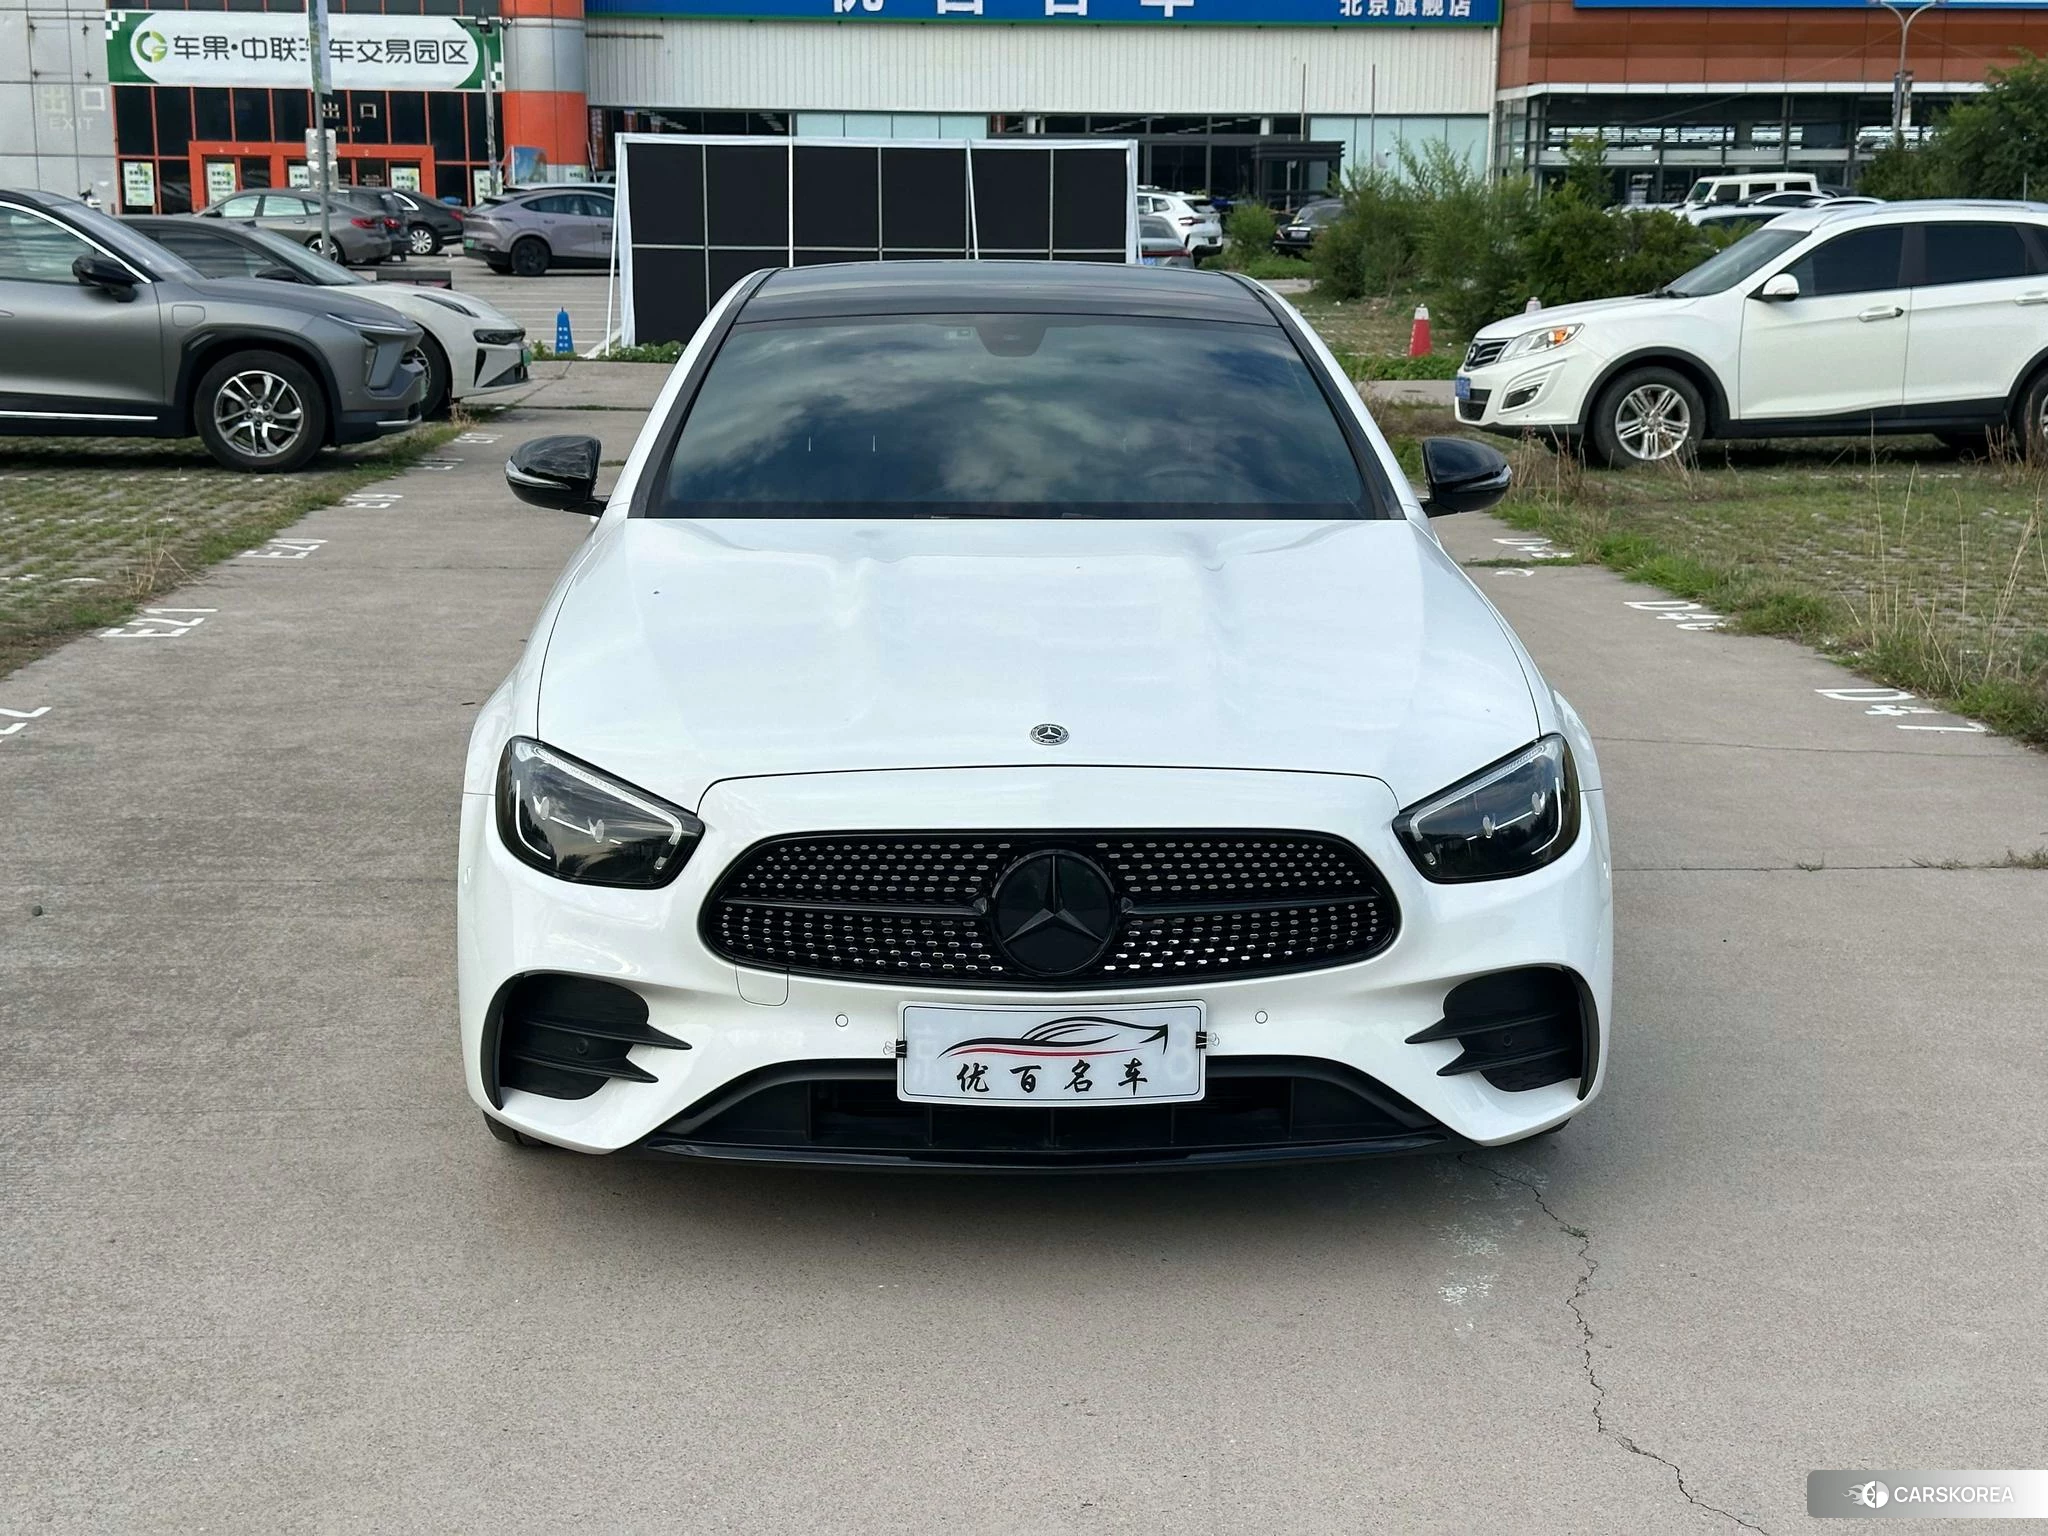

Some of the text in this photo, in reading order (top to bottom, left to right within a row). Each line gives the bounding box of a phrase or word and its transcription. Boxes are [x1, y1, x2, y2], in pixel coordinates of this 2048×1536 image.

[1340, 0, 1471, 17] 北京旗舰店
[238, 537, 329, 559] E20
[99, 608, 219, 637] E21
[1814, 688, 1988, 732] D47
[956, 1058, 1148, 1096] 优百名车
